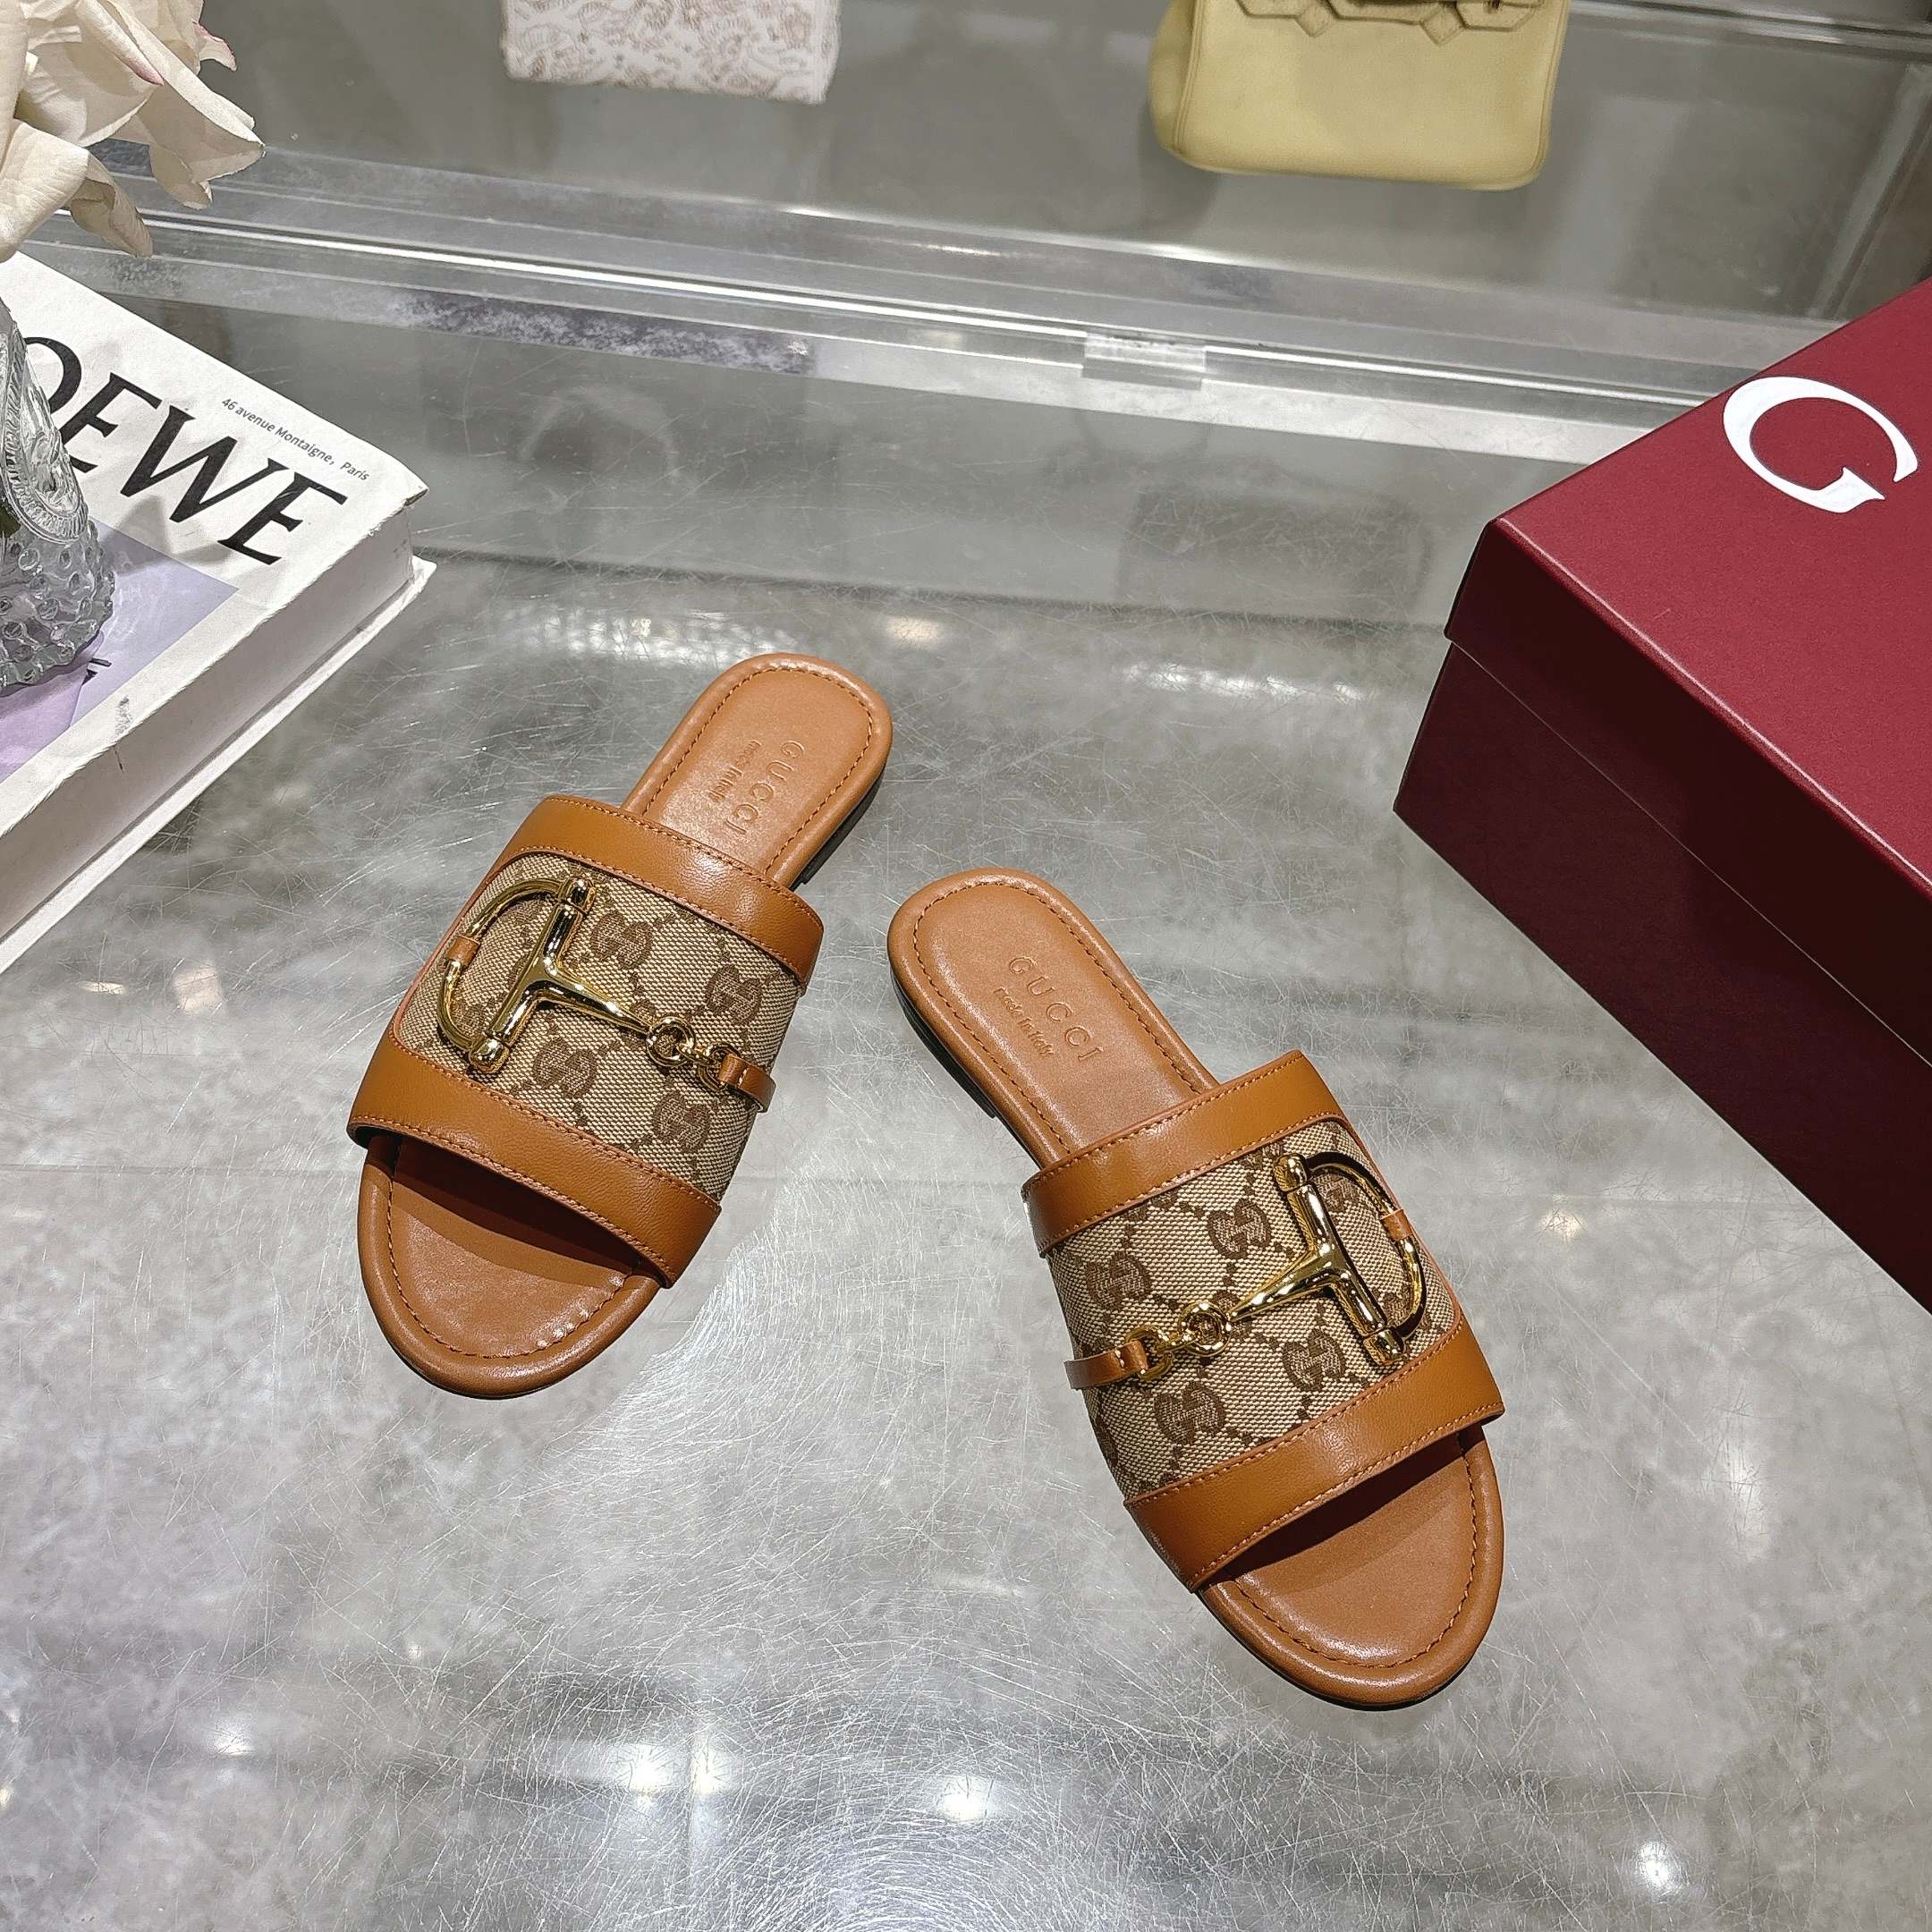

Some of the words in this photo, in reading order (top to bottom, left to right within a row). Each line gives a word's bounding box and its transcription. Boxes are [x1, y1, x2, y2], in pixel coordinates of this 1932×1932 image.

[221, 398, 239, 411] 46
[235, 406, 276, 432] avenue
[275, 427, 335, 466] Montaigne,
[340, 462, 370, 481] Paris
[1723, 376, 1919, 514] G
[724, 740, 805, 835] GUCCI
[1009, 956, 1104, 1063] GUCCI
